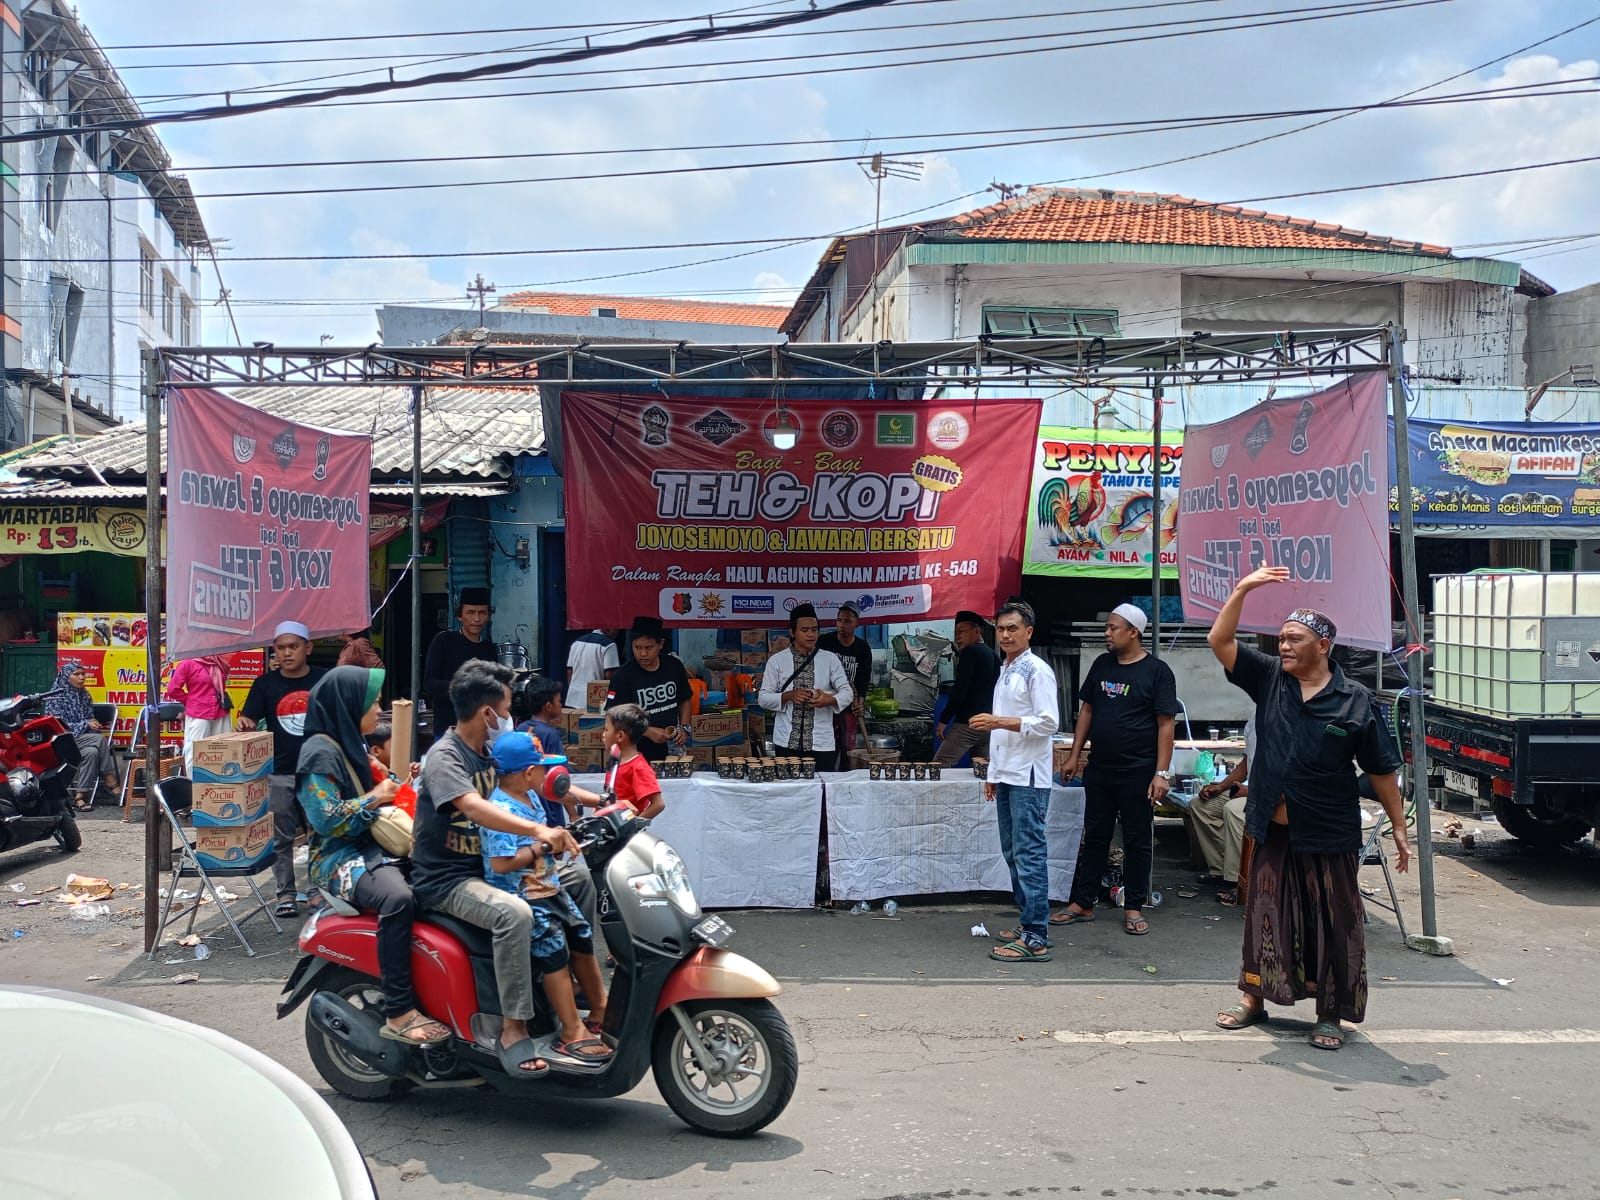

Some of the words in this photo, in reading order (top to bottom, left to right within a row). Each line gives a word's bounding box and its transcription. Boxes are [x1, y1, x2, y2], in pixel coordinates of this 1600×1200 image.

[1429, 432, 1488, 451] Aneka
[1491, 434, 1556, 453] Macam
[735, 450, 783, 475] Bagi
[814, 451, 863, 476] Bagi
[1516, 456, 1575, 471] AFIFAH
[915, 461, 959, 485] GRATIS
[1102, 475, 1135, 487] TAHU
[653, 470, 758, 518] TEH
[759, 471, 809, 520] &
[810, 472, 940, 521] KOPI
[0, 507, 98, 524] MARTABAK
[1389, 502, 1420, 512] Keb
[1428, 502, 1458, 512] Kebab
[1461, 502, 1490, 513] Manis
[1498, 504, 1519, 513] Roti
[1521, 504, 1562, 514] Maryam
[7, 528, 31, 544] Rp:
[38, 527, 78, 549] 13
[638, 524, 766, 551] JOYOSEMOYO
[768, 530, 785, 551] &
[786, 527, 867, 552] JAWARA
[869, 526, 955, 552] BERSATU
[1057, 549, 1090, 561] AYAM
[1110, 551, 1139, 563] NILA
[611, 565, 661, 581] Dalam
[666, 565, 722, 586] Rangka
[726, 566, 764, 583] HAUL
[767, 566, 819, 584] AGUNG
[822, 566, 872, 584] SUNAN
[875, 565, 921, 582] AMPEL
[924, 562, 942, 578] KE
[117, 668, 147, 685] Neh
[637, 681, 677, 710] JSCO
[702, 720, 731, 732] Orchid
[209, 790, 236, 800] Orchid
[640, 900, 668, 908] Supreme
